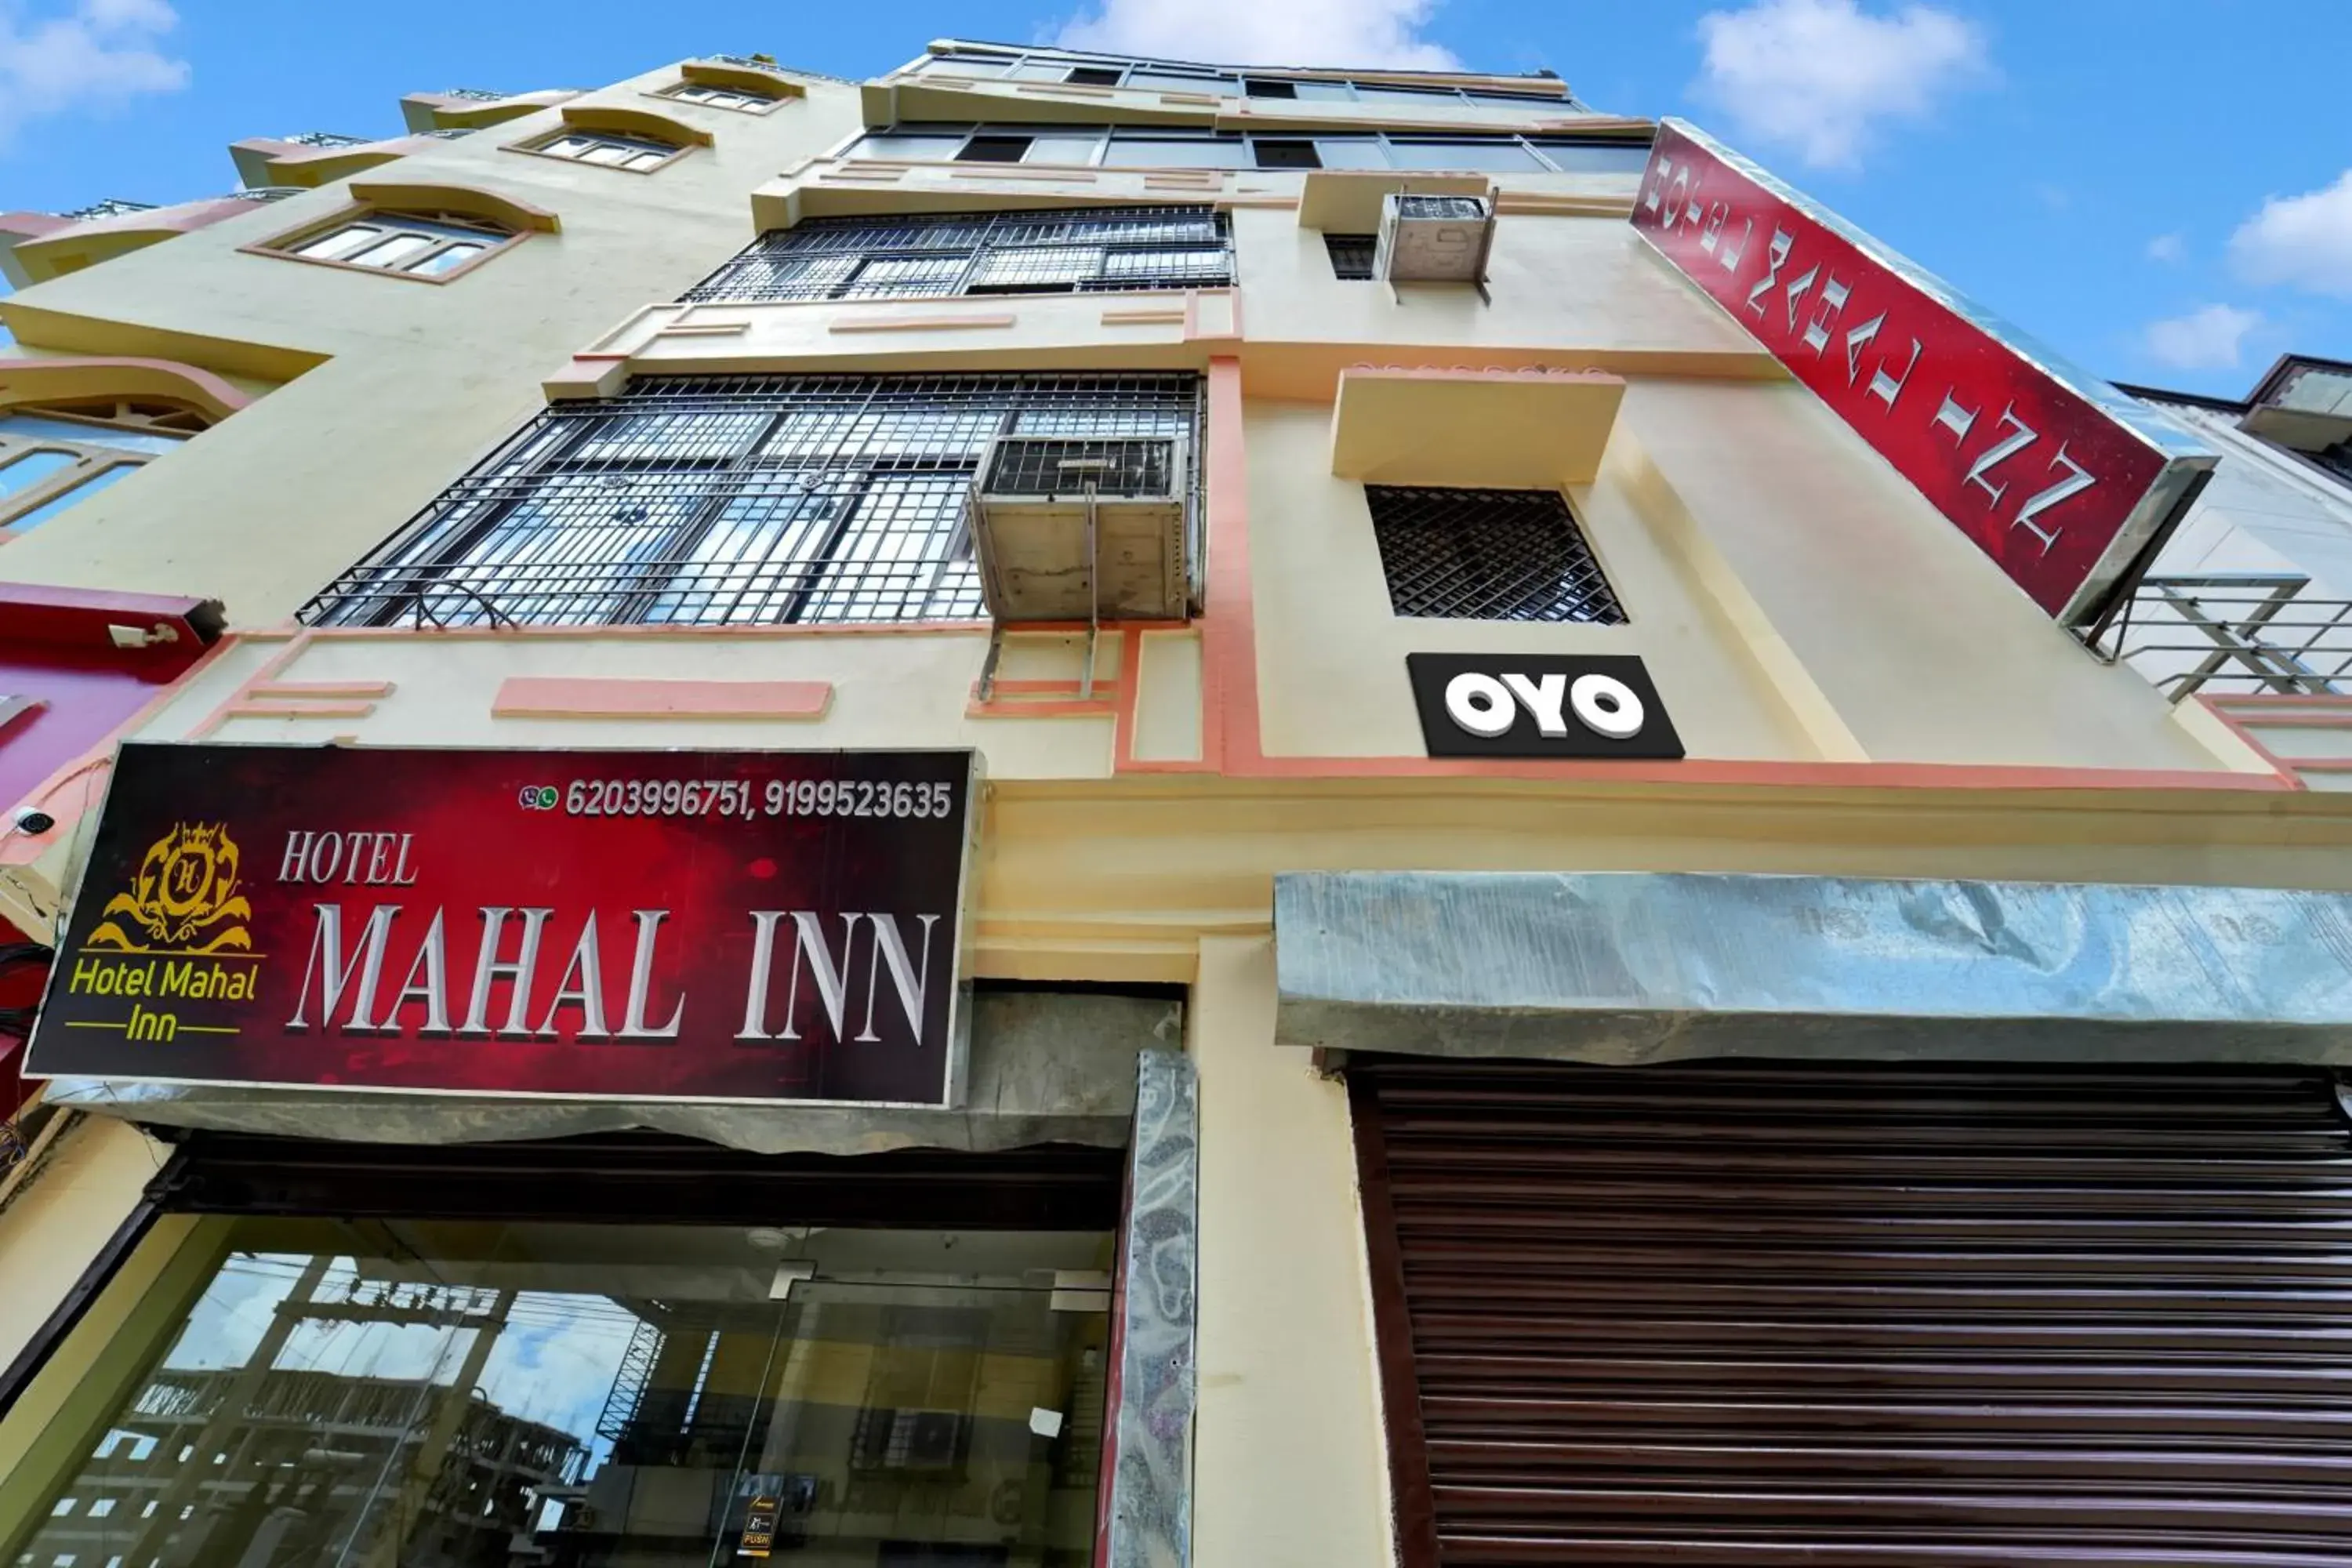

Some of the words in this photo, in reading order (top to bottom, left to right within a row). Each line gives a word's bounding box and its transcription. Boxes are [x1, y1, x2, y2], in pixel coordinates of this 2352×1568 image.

[1645, 151, 1753, 274] HOTEL
[1744, 220, 1922, 413] MAHAL
[1931, 385, 2097, 557] INN
[1445, 672, 1645, 739] OYO
[565, 779, 755, 821] 6203996751,
[764, 779, 952, 818] 9199523635
[277, 829, 419, 885] HOTEL
[68, 957, 157, 996] Hotel
[159, 960, 259, 1000] Mahal
[285, 903, 686, 1039] MAHAL
[733, 909, 941, 1047] INN
[125, 1003, 177, 1042] Inn
[743, 1534, 770, 1544] PUSH
